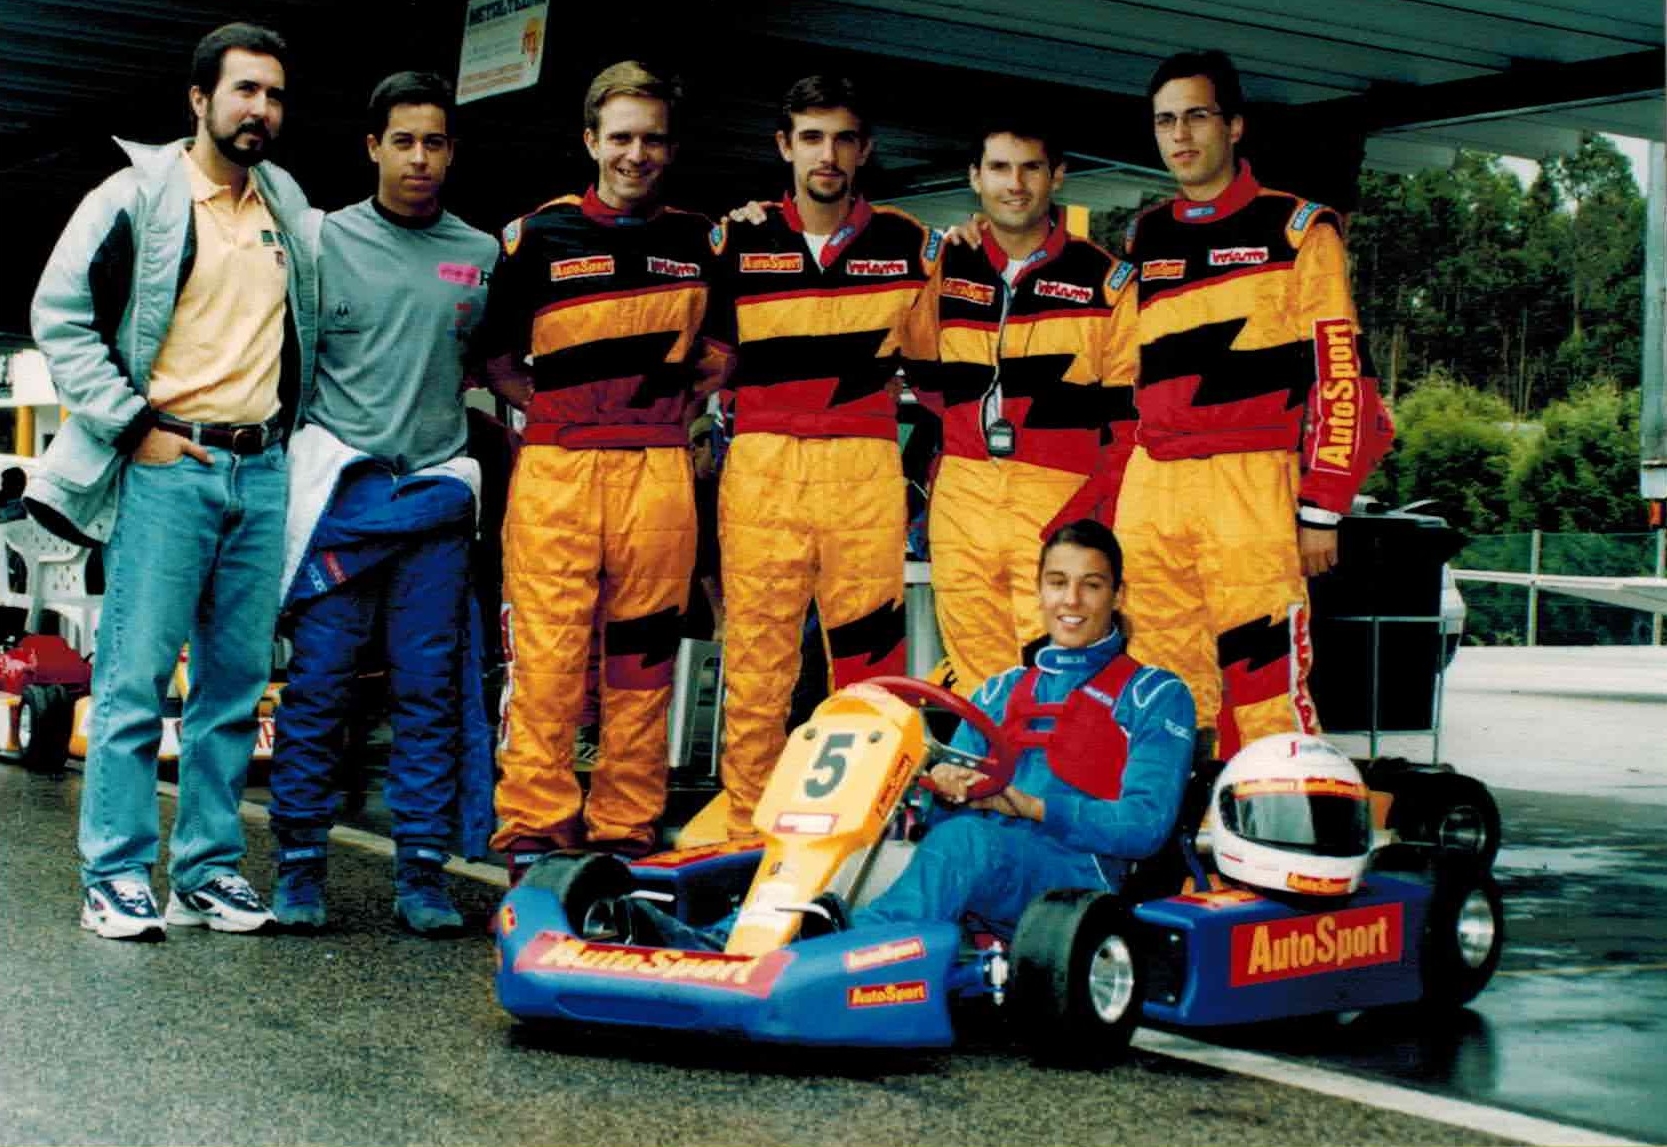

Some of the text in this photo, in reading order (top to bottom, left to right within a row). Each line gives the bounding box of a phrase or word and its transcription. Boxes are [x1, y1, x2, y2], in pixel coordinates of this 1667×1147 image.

[1318, 323, 1357, 469] AutoSport
[804, 733, 856, 799] 5
[536, 939, 760, 985] AutoSport
[1247, 914, 1389, 976] AutoSport
[852, 985, 925, 1005] AutoSport
